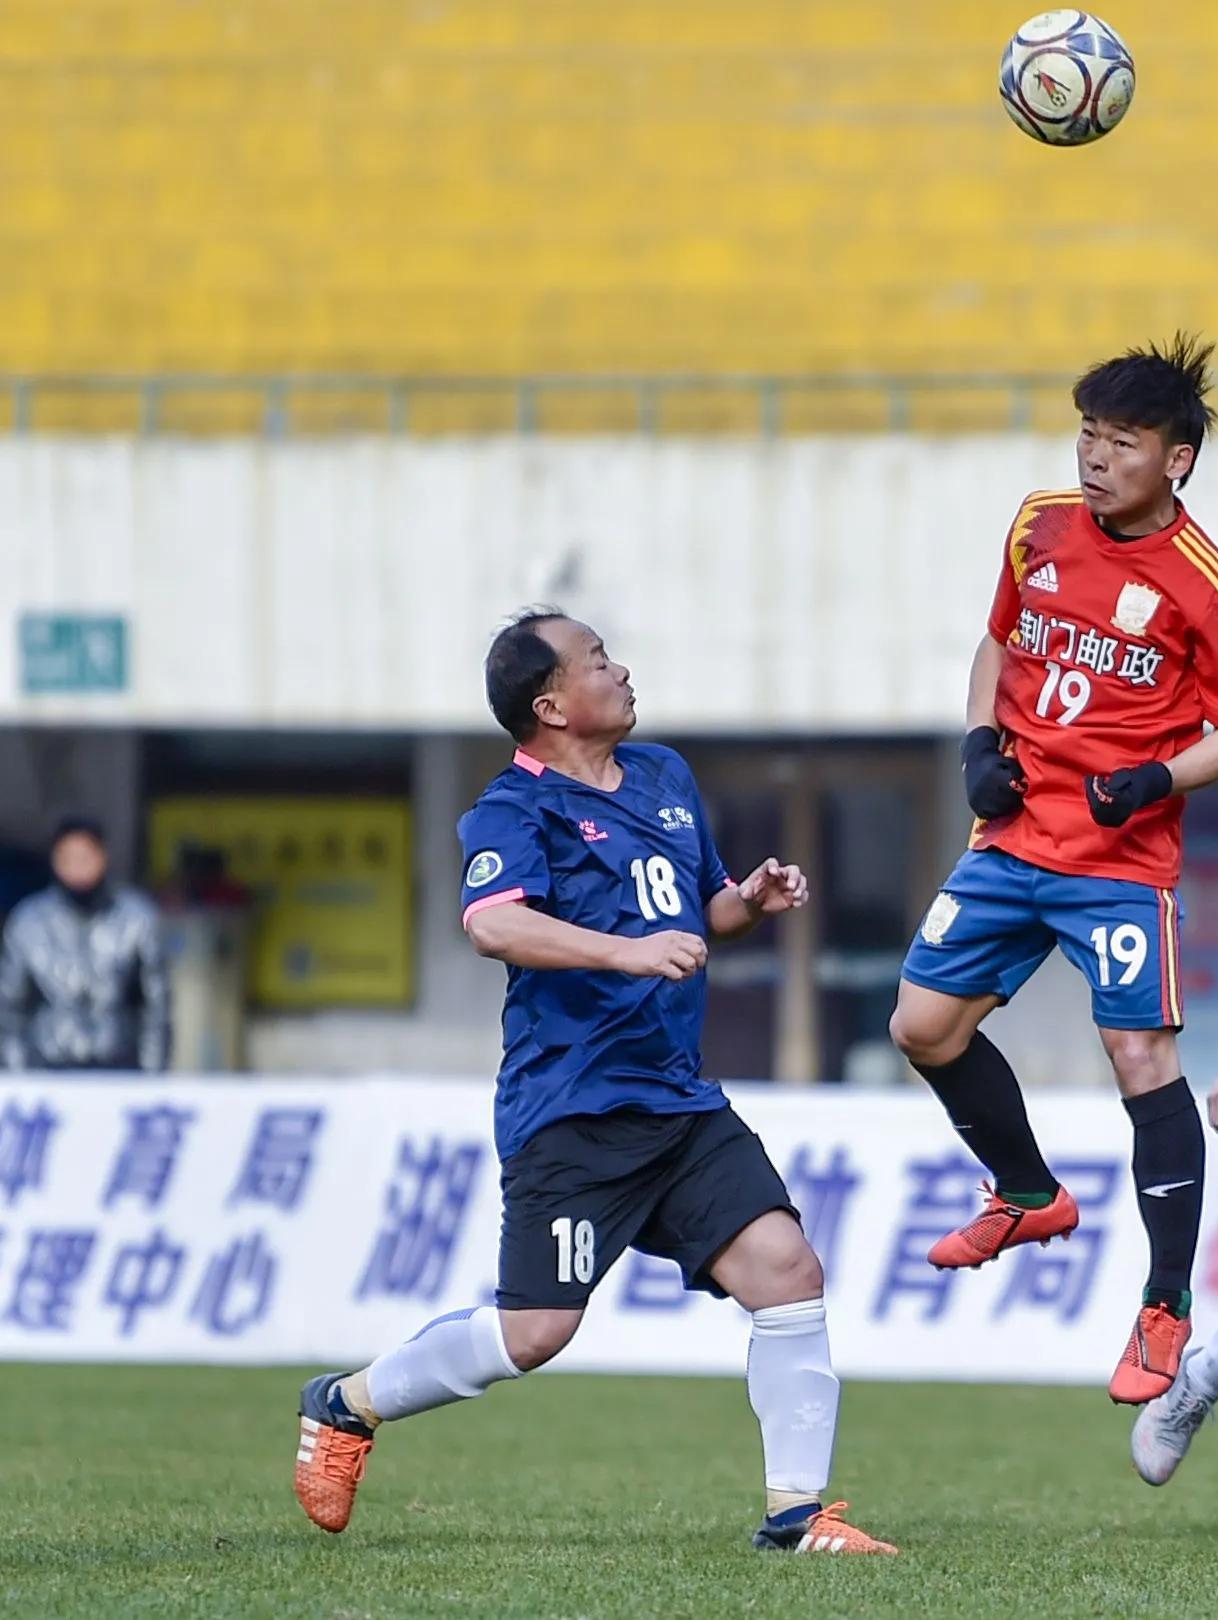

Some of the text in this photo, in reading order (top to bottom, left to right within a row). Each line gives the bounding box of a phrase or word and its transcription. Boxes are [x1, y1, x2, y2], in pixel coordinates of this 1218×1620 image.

[1027, 575, 1059, 593] adidas
[1019, 608, 1163, 686] 荆门邮政
[1035, 661, 1091, 727] 19
[630, 855, 682, 921] 18
[1090, 923, 1148, 986] 19
[0, 1227, 278, 1336] 理中心
[551, 1217, 595, 1285] 18
